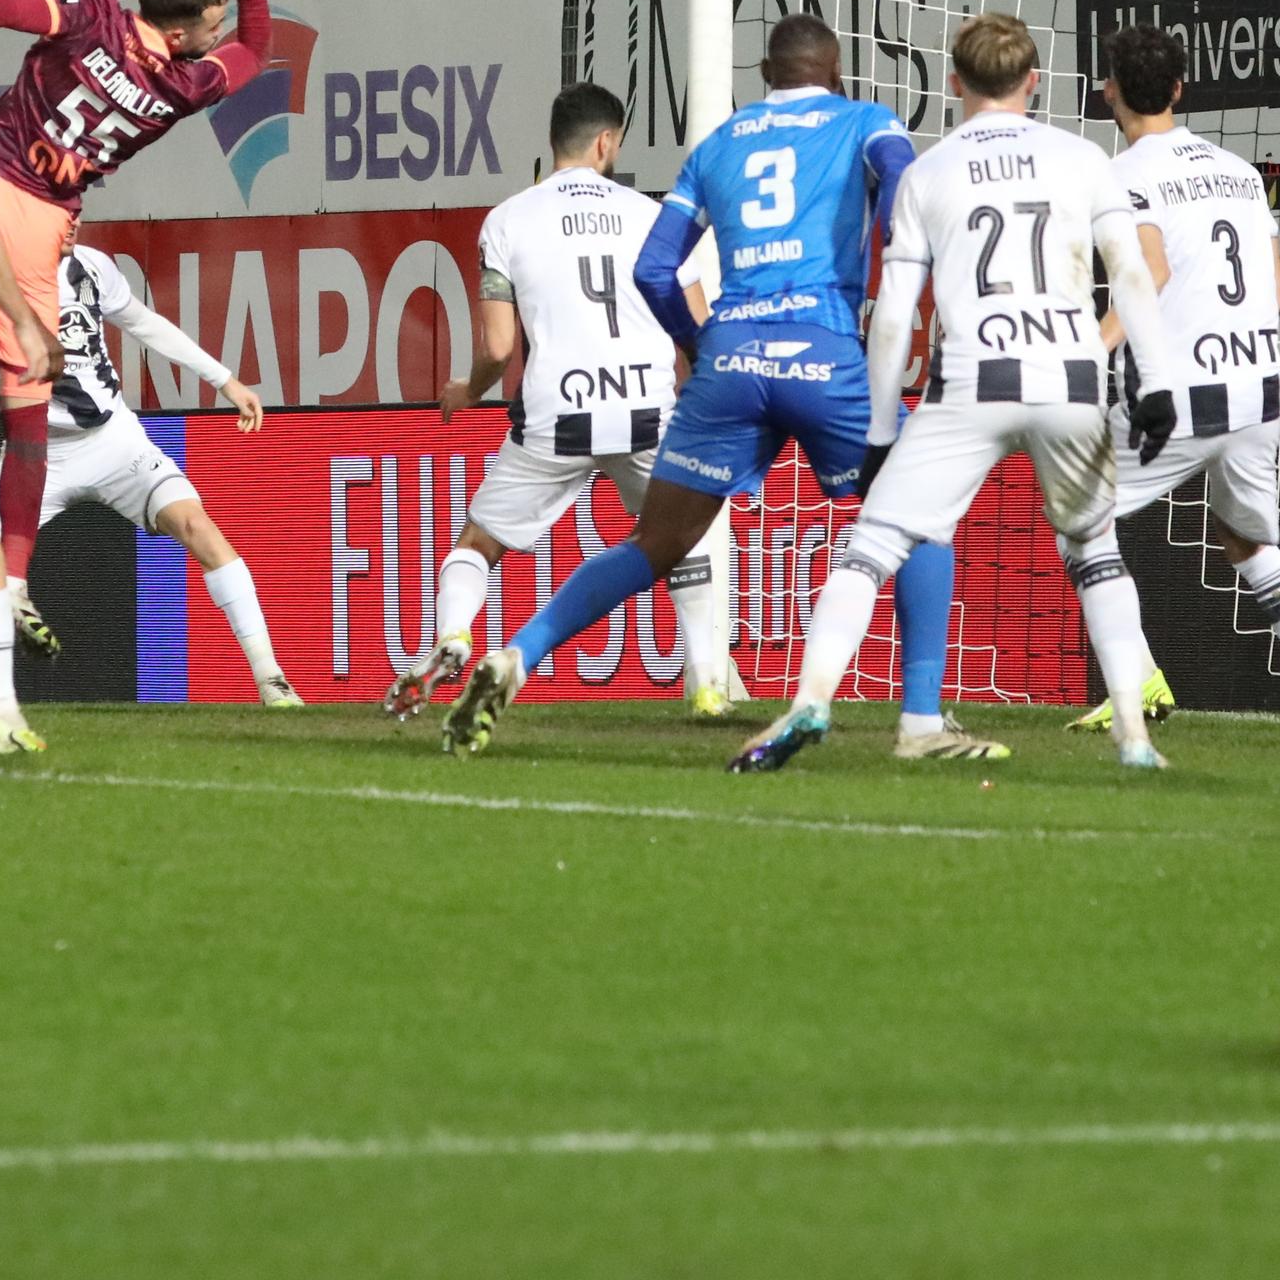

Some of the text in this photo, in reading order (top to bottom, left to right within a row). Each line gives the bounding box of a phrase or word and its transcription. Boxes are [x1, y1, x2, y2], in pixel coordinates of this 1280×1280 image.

[43, 83, 142, 163] 55
[325, 64, 503, 182] BESIX
[741, 147, 797, 229] 3
[968, 154, 1037, 185] BLUM
[1157, 181, 1184, 206] VAN
[1189, 175, 1213, 201] DEN
[562, 211, 623, 237] OUSOU
[967, 200, 1052, 298] 27
[1211, 219, 1246, 307] 3
[577, 254, 621, 339] 4
[718, 294, 818, 322] CARGLASS
[714, 355, 832, 382] CARGLASS
